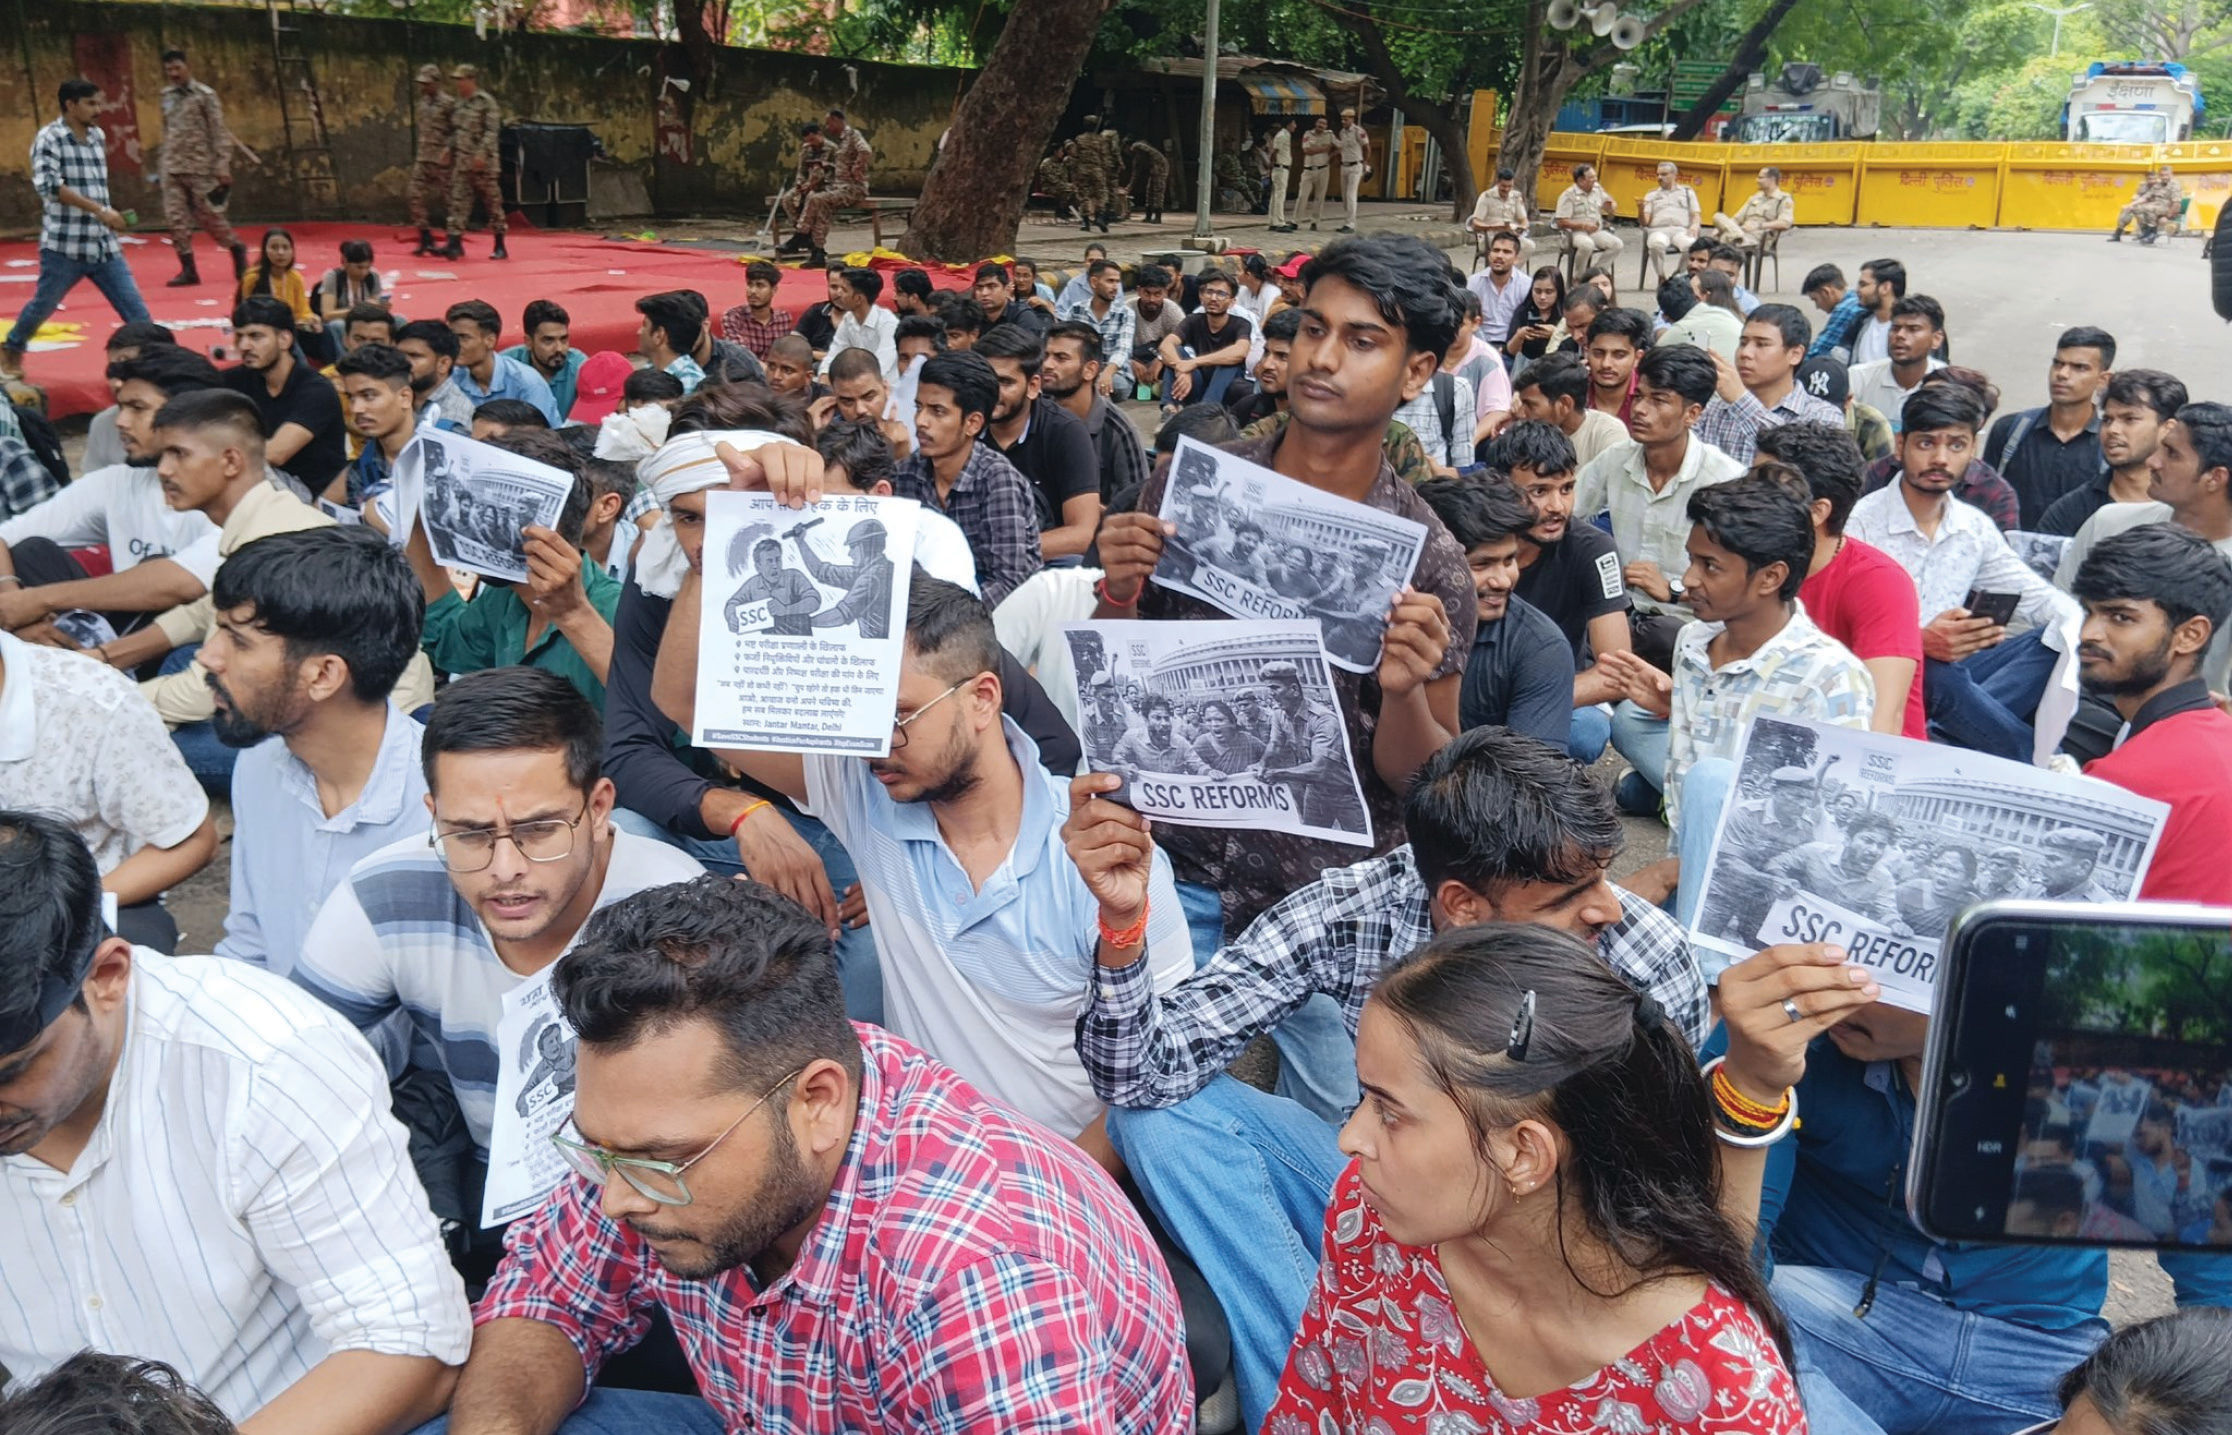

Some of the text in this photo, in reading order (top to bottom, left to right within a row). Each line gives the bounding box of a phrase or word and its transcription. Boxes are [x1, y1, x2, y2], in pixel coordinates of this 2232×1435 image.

[837, 496, 850, 511] के
[855, 496, 880, 514] लिए
[1203, 571, 1237, 600] SSC
[740, 608, 768, 627] SSC
[764, 720, 787, 729] Jantar
[822, 722, 842, 731] Delhi
[1867, 753, 1893, 771] SSC
[1143, 783, 1290, 811] SSC REFORMS
[1781, 904, 1937, 984] SSC REFOR
[529, 1083, 552, 1109] SSC
